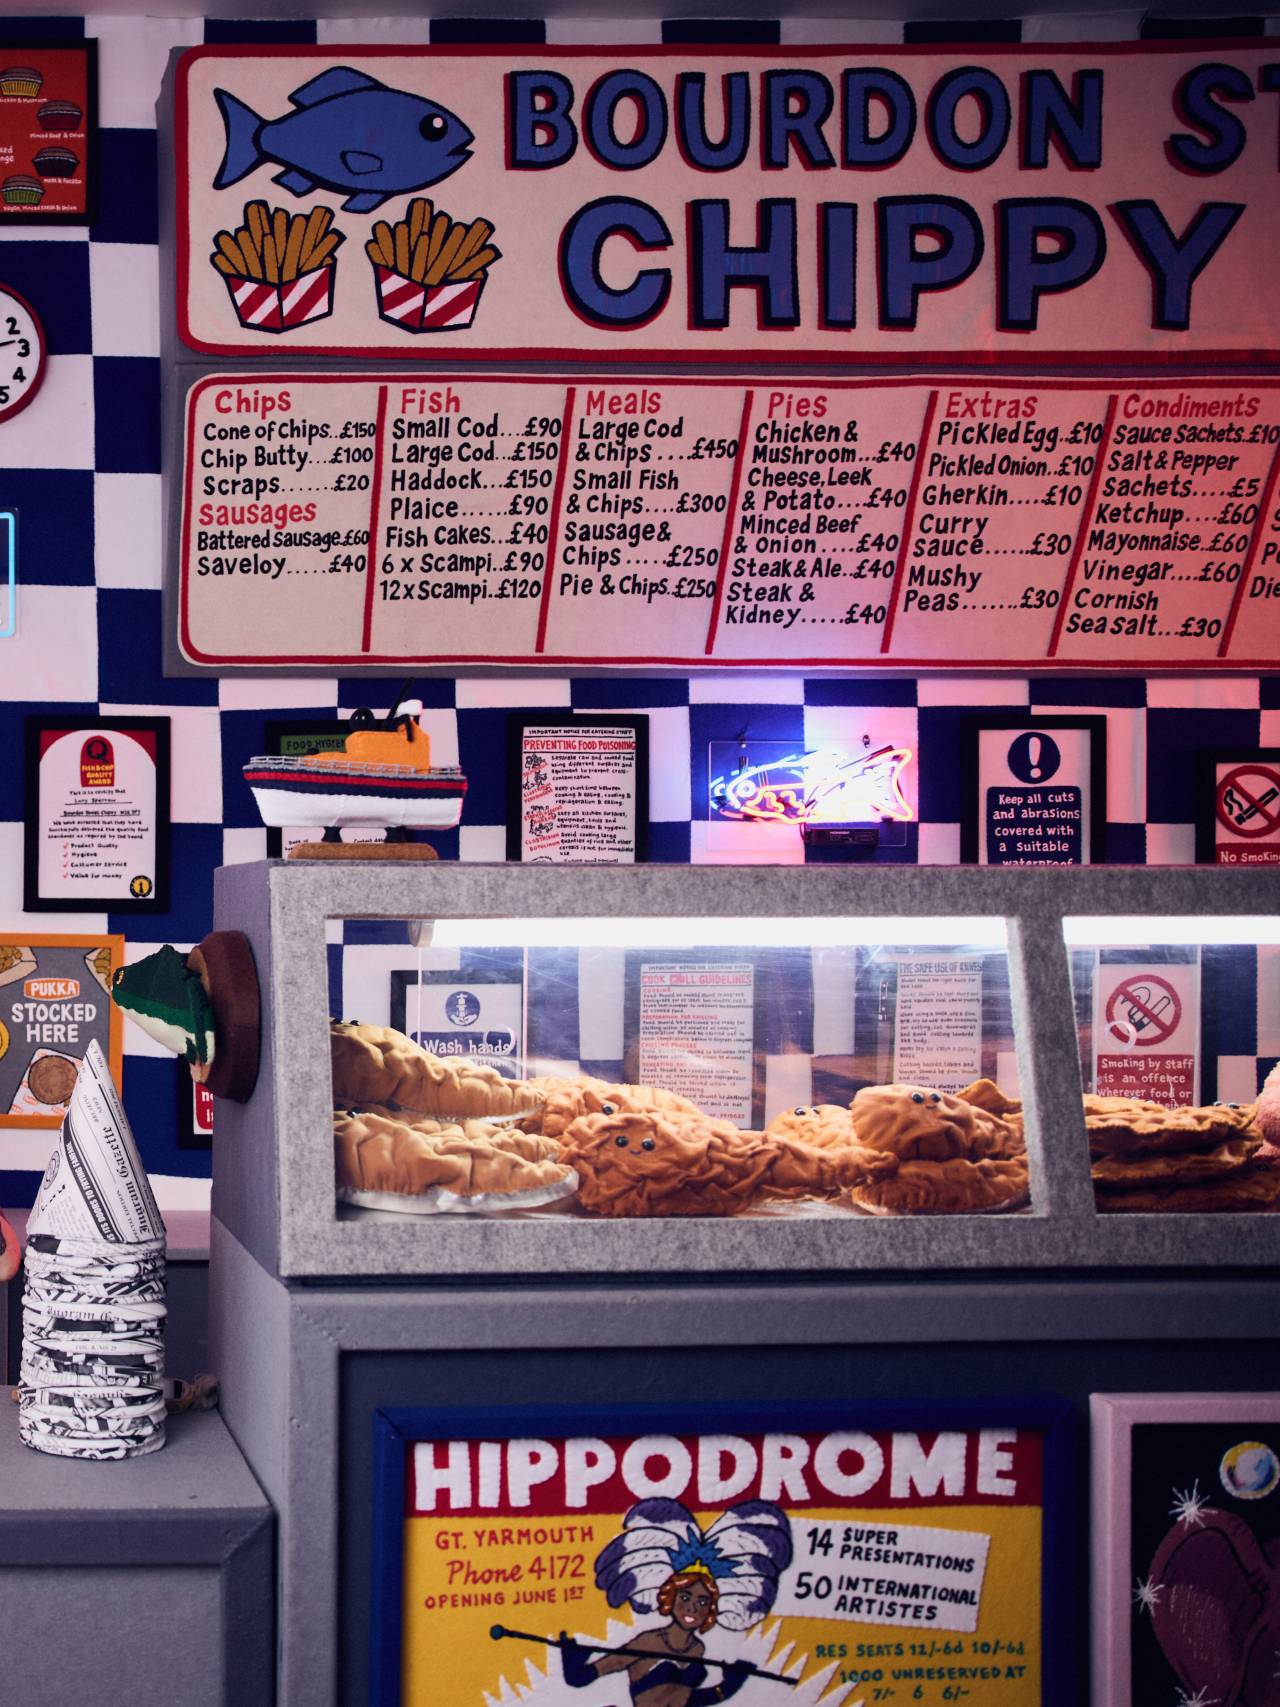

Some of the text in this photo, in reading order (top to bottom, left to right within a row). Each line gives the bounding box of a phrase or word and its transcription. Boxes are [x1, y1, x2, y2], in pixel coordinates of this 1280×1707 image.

[505, 67, 1104, 172] BOURDON
[558, 195, 1246, 333] CHIPPY
[6, 317, 21, 335] 2
[17, 339, 31, 357] 3
[12, 366, 26, 383] 4
[215, 390, 291, 418] Chips
[401, 388, 461, 414] Fish
[587, 390, 661, 415] Meals
[768, 392, 828, 419] Pies
[945, 391, 1038, 418] Extras
[1123, 392, 1260, 419] Condiments
[204, 423, 250, 440] Cone
[255, 421, 275, 438] of
[392, 413, 562, 439] Small Cod £90
[755, 421, 859, 443] Chicken &
[201, 446, 373, 473] Chip Butty £100
[752, 443, 916, 465] Mushroom £40
[199, 502, 317, 529] Sausages
[920, 513, 988, 538] Curry
[1030, 533, 1071, 556] £30
[197, 555, 367, 579] Saveloy £40
[1075, 587, 1158, 611] Cornish
[1066, 613, 1221, 638] Sea Salt £30
[524, 739, 637, 751] PREVENTING FOOD POISONING
[998, 791, 1075, 806] Keep all cuts
[992, 808, 1080, 820] and abrasions
[994, 825, 1074, 836] covered with
[999, 842, 1007, 852] a
[1220, 850, 1280, 863] No Smokin
[30, 981, 78, 997] PUKKA
[11, 1002, 96, 1023] STOCKED
[26, 1023, 79, 1043] HERE
[424, 1039, 511, 1056] Wash hands
[1101, 1057, 1194, 1070] Smoking by staff
[1104, 1072, 1186, 1084] is an offence
[1150, 1088, 1175, 1099] food
[1179, 1089, 1192, 1098] or
[414, 1428, 1017, 1511] HIPPODROME
[435, 1526, 593, 1550] GT. YARMOUTH
[807, 1527, 898, 1556] 14 SUPER
[446, 1554, 586, 1585] Phone 4172
[840, 1544, 975, 1573] PRESENTATIONS
[424, 1591, 504, 1610] OPENING
[513, 1588, 556, 1605] JUNE
[794, 1571, 977, 1606] 50 INTERNATIONAL
[834, 1595, 938, 1620] ARTISTES
[815, 1643, 847, 1658] RES
[856, 1642, 905, 1657] SEATS
[840, 1665, 1027, 1683] 1000 UNRESERVED AT
